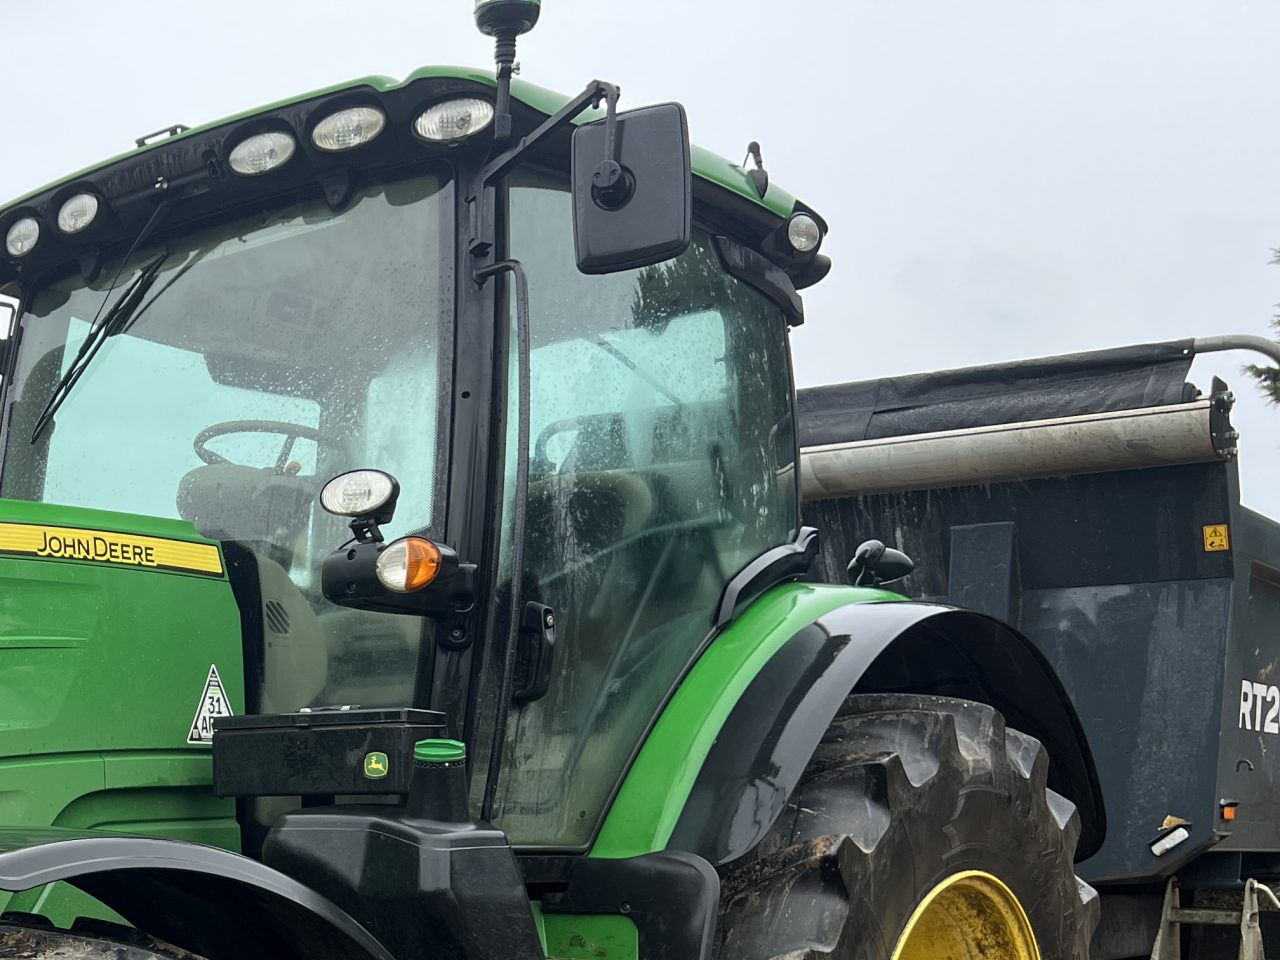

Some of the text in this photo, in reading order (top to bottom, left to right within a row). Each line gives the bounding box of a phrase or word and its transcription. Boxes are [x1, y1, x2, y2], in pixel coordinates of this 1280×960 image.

[37, 531, 155, 563] JOHN DEERE
[207, 695, 223, 715] 31
[1238, 679, 1280, 734] RT2
